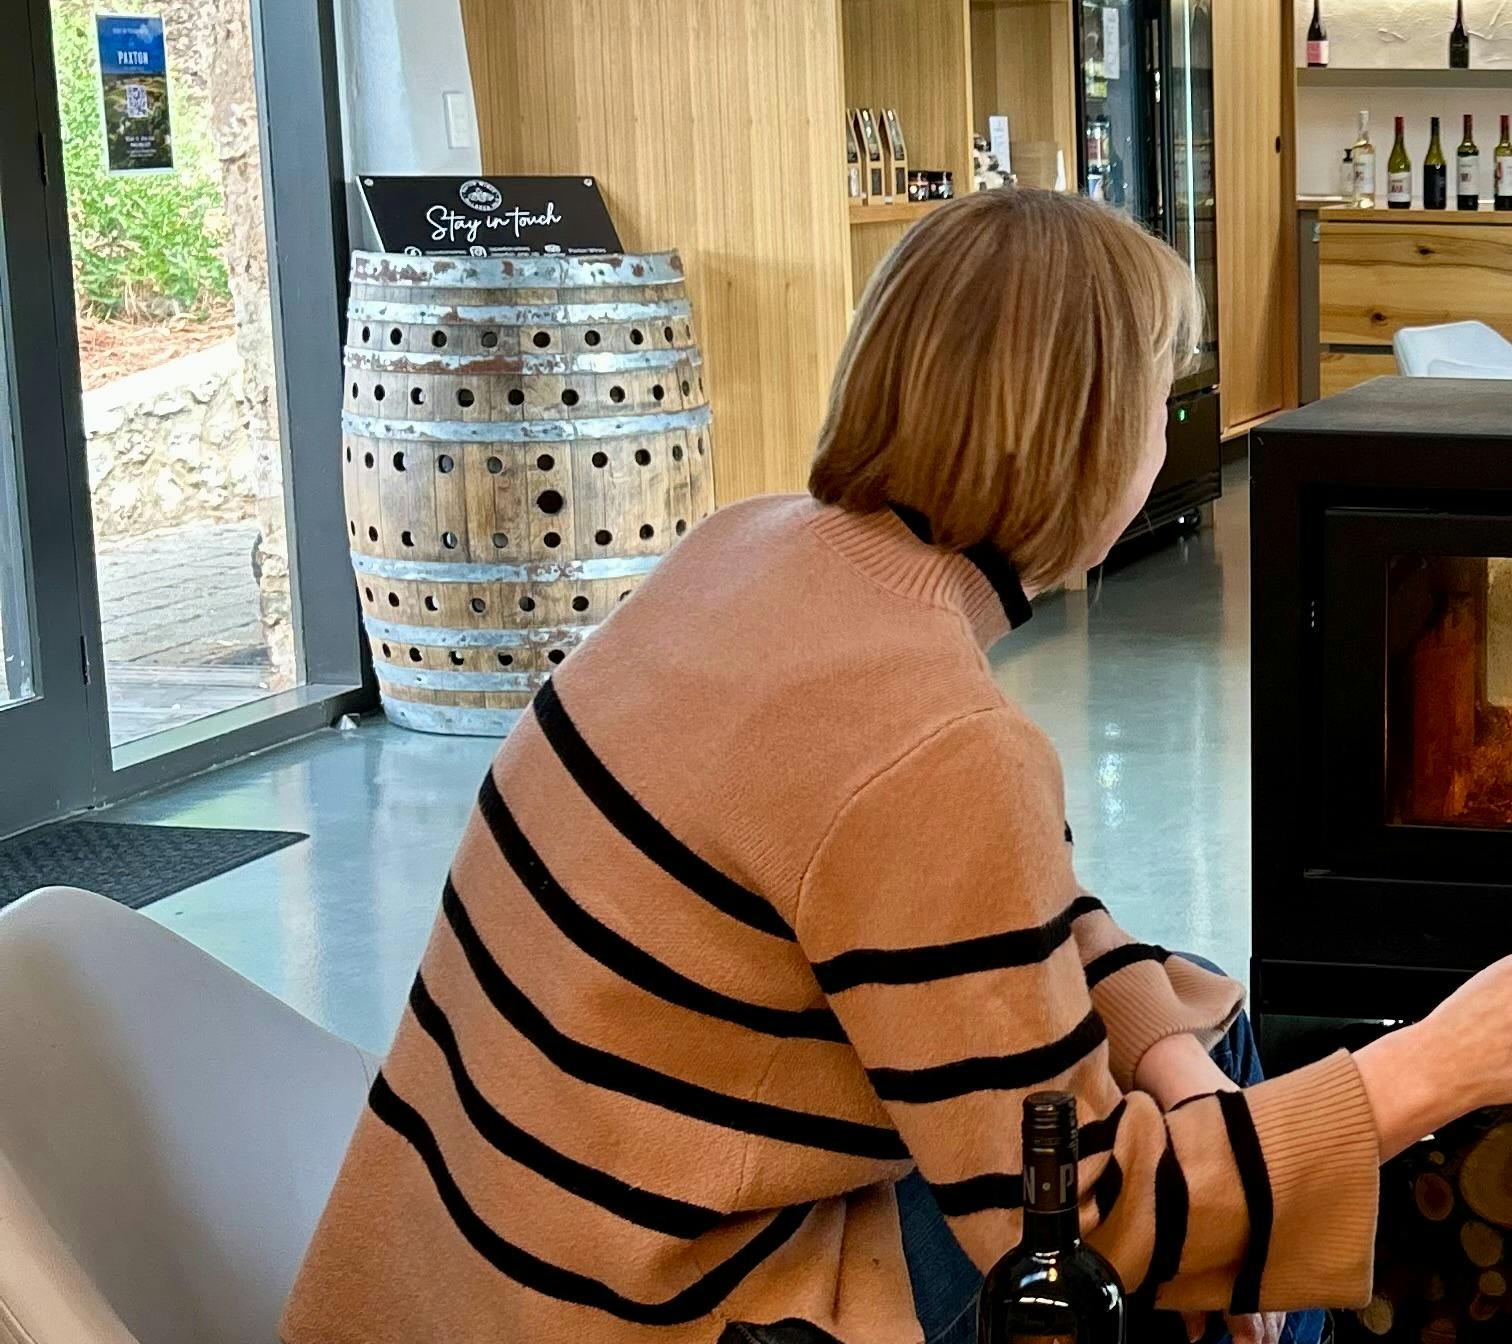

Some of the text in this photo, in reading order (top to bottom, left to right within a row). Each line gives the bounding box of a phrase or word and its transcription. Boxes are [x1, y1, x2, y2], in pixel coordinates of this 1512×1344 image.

[117, 50, 149, 65] PAXTON
[426, 202, 562, 242] Stay in touch
